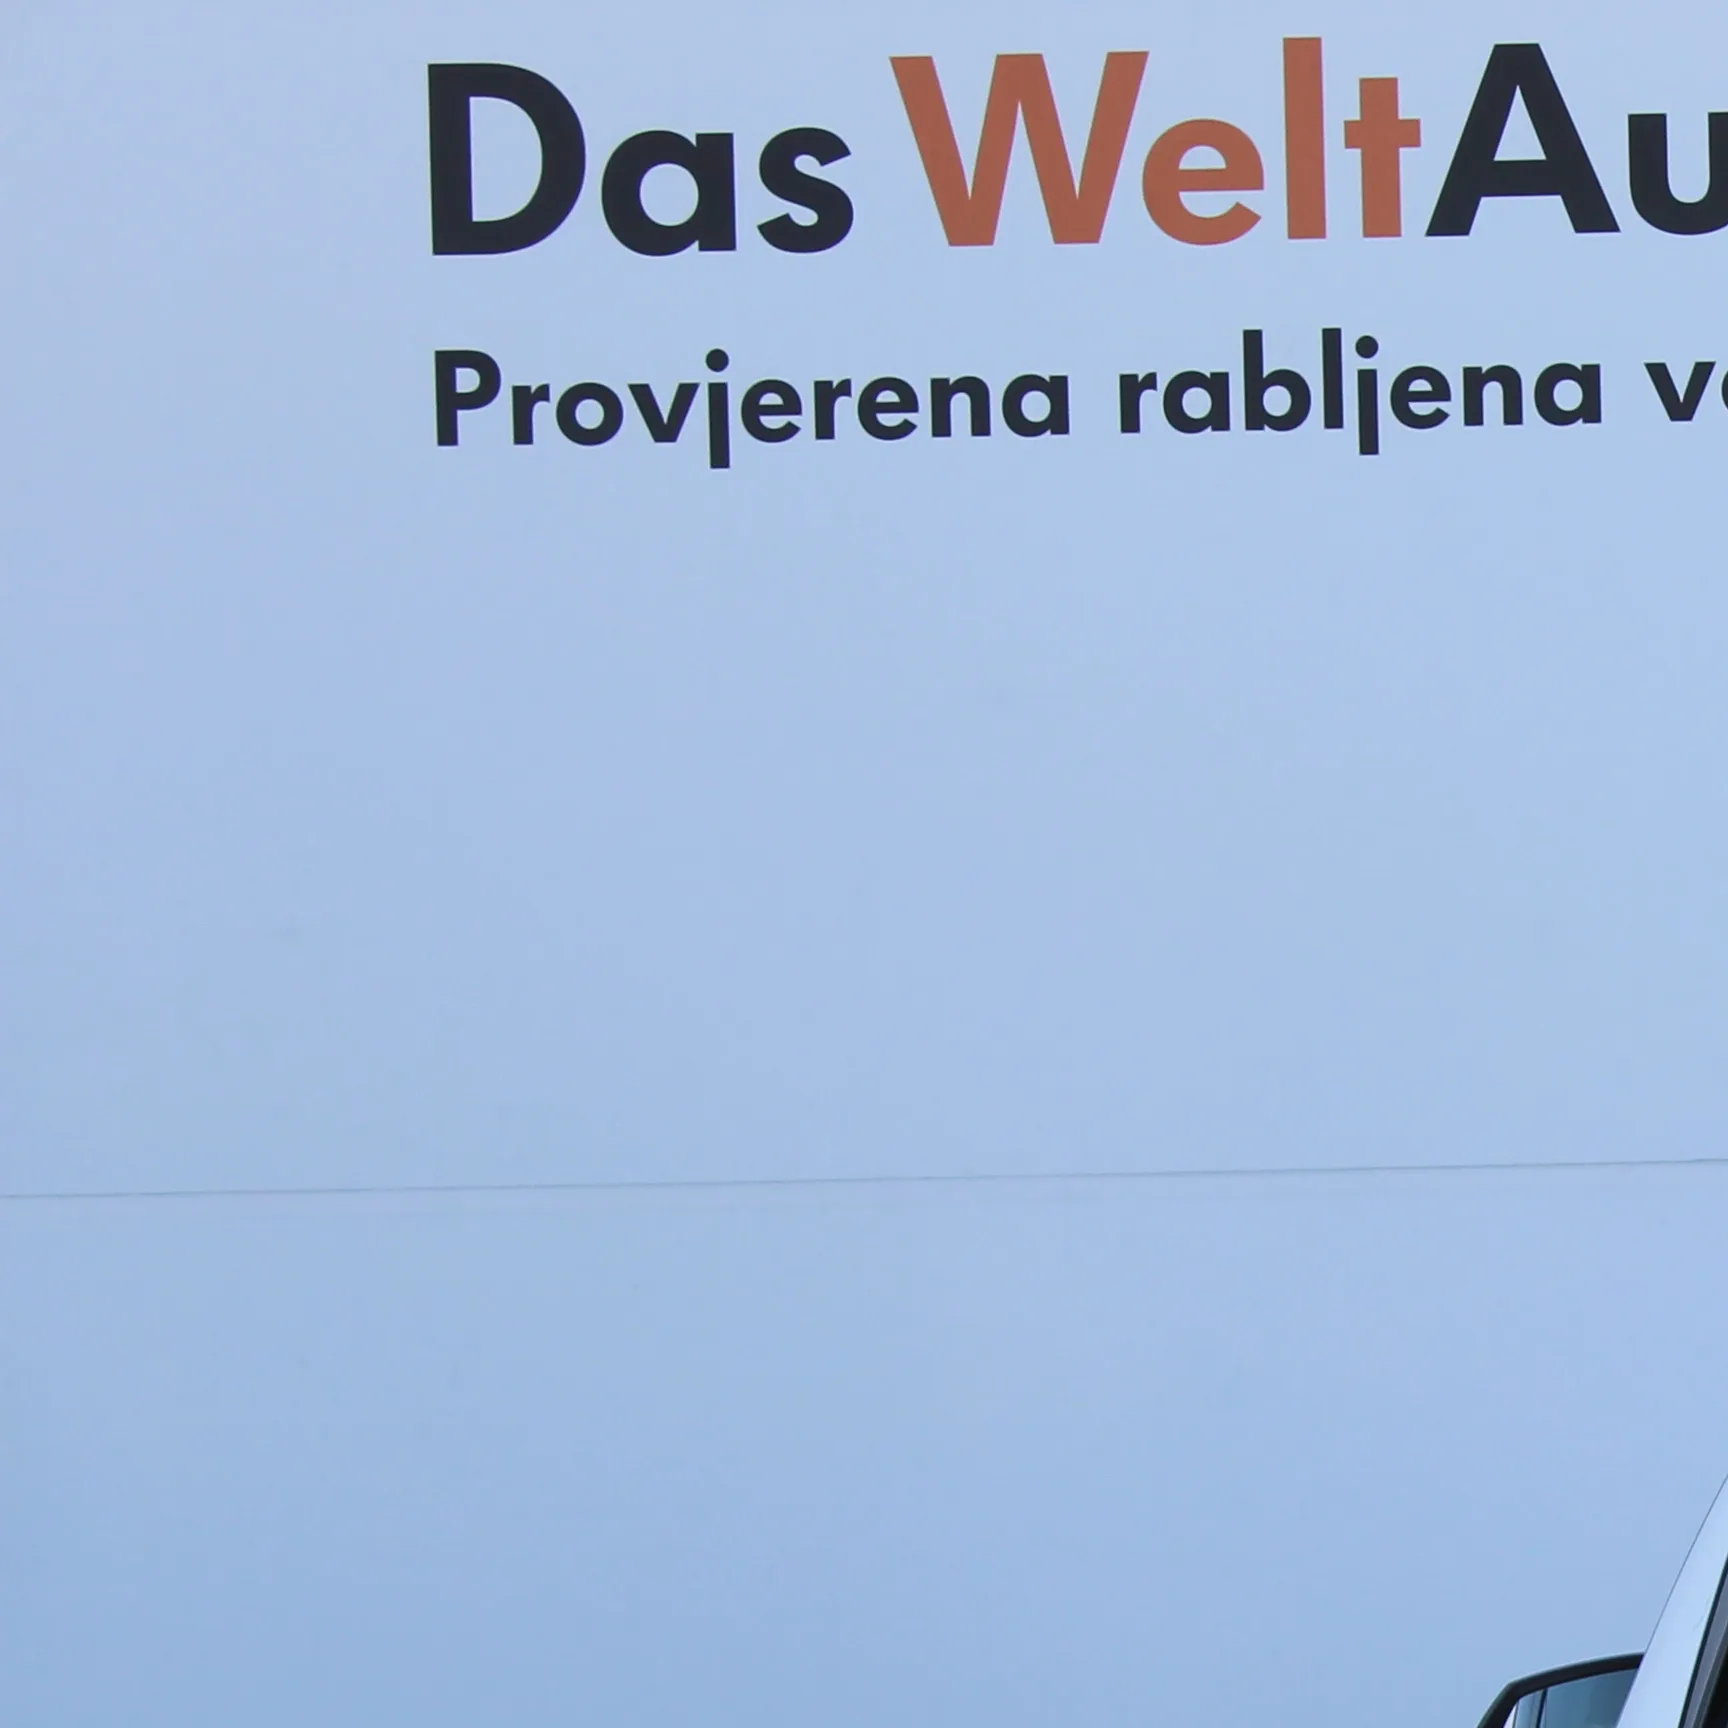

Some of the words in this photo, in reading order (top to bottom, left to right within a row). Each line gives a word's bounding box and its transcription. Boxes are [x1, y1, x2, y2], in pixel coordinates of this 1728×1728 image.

[427, 62, 854, 257] Das
[433, 347, 1070, 470] Provjerena
[1118, 327, 1603, 456] rabljena
